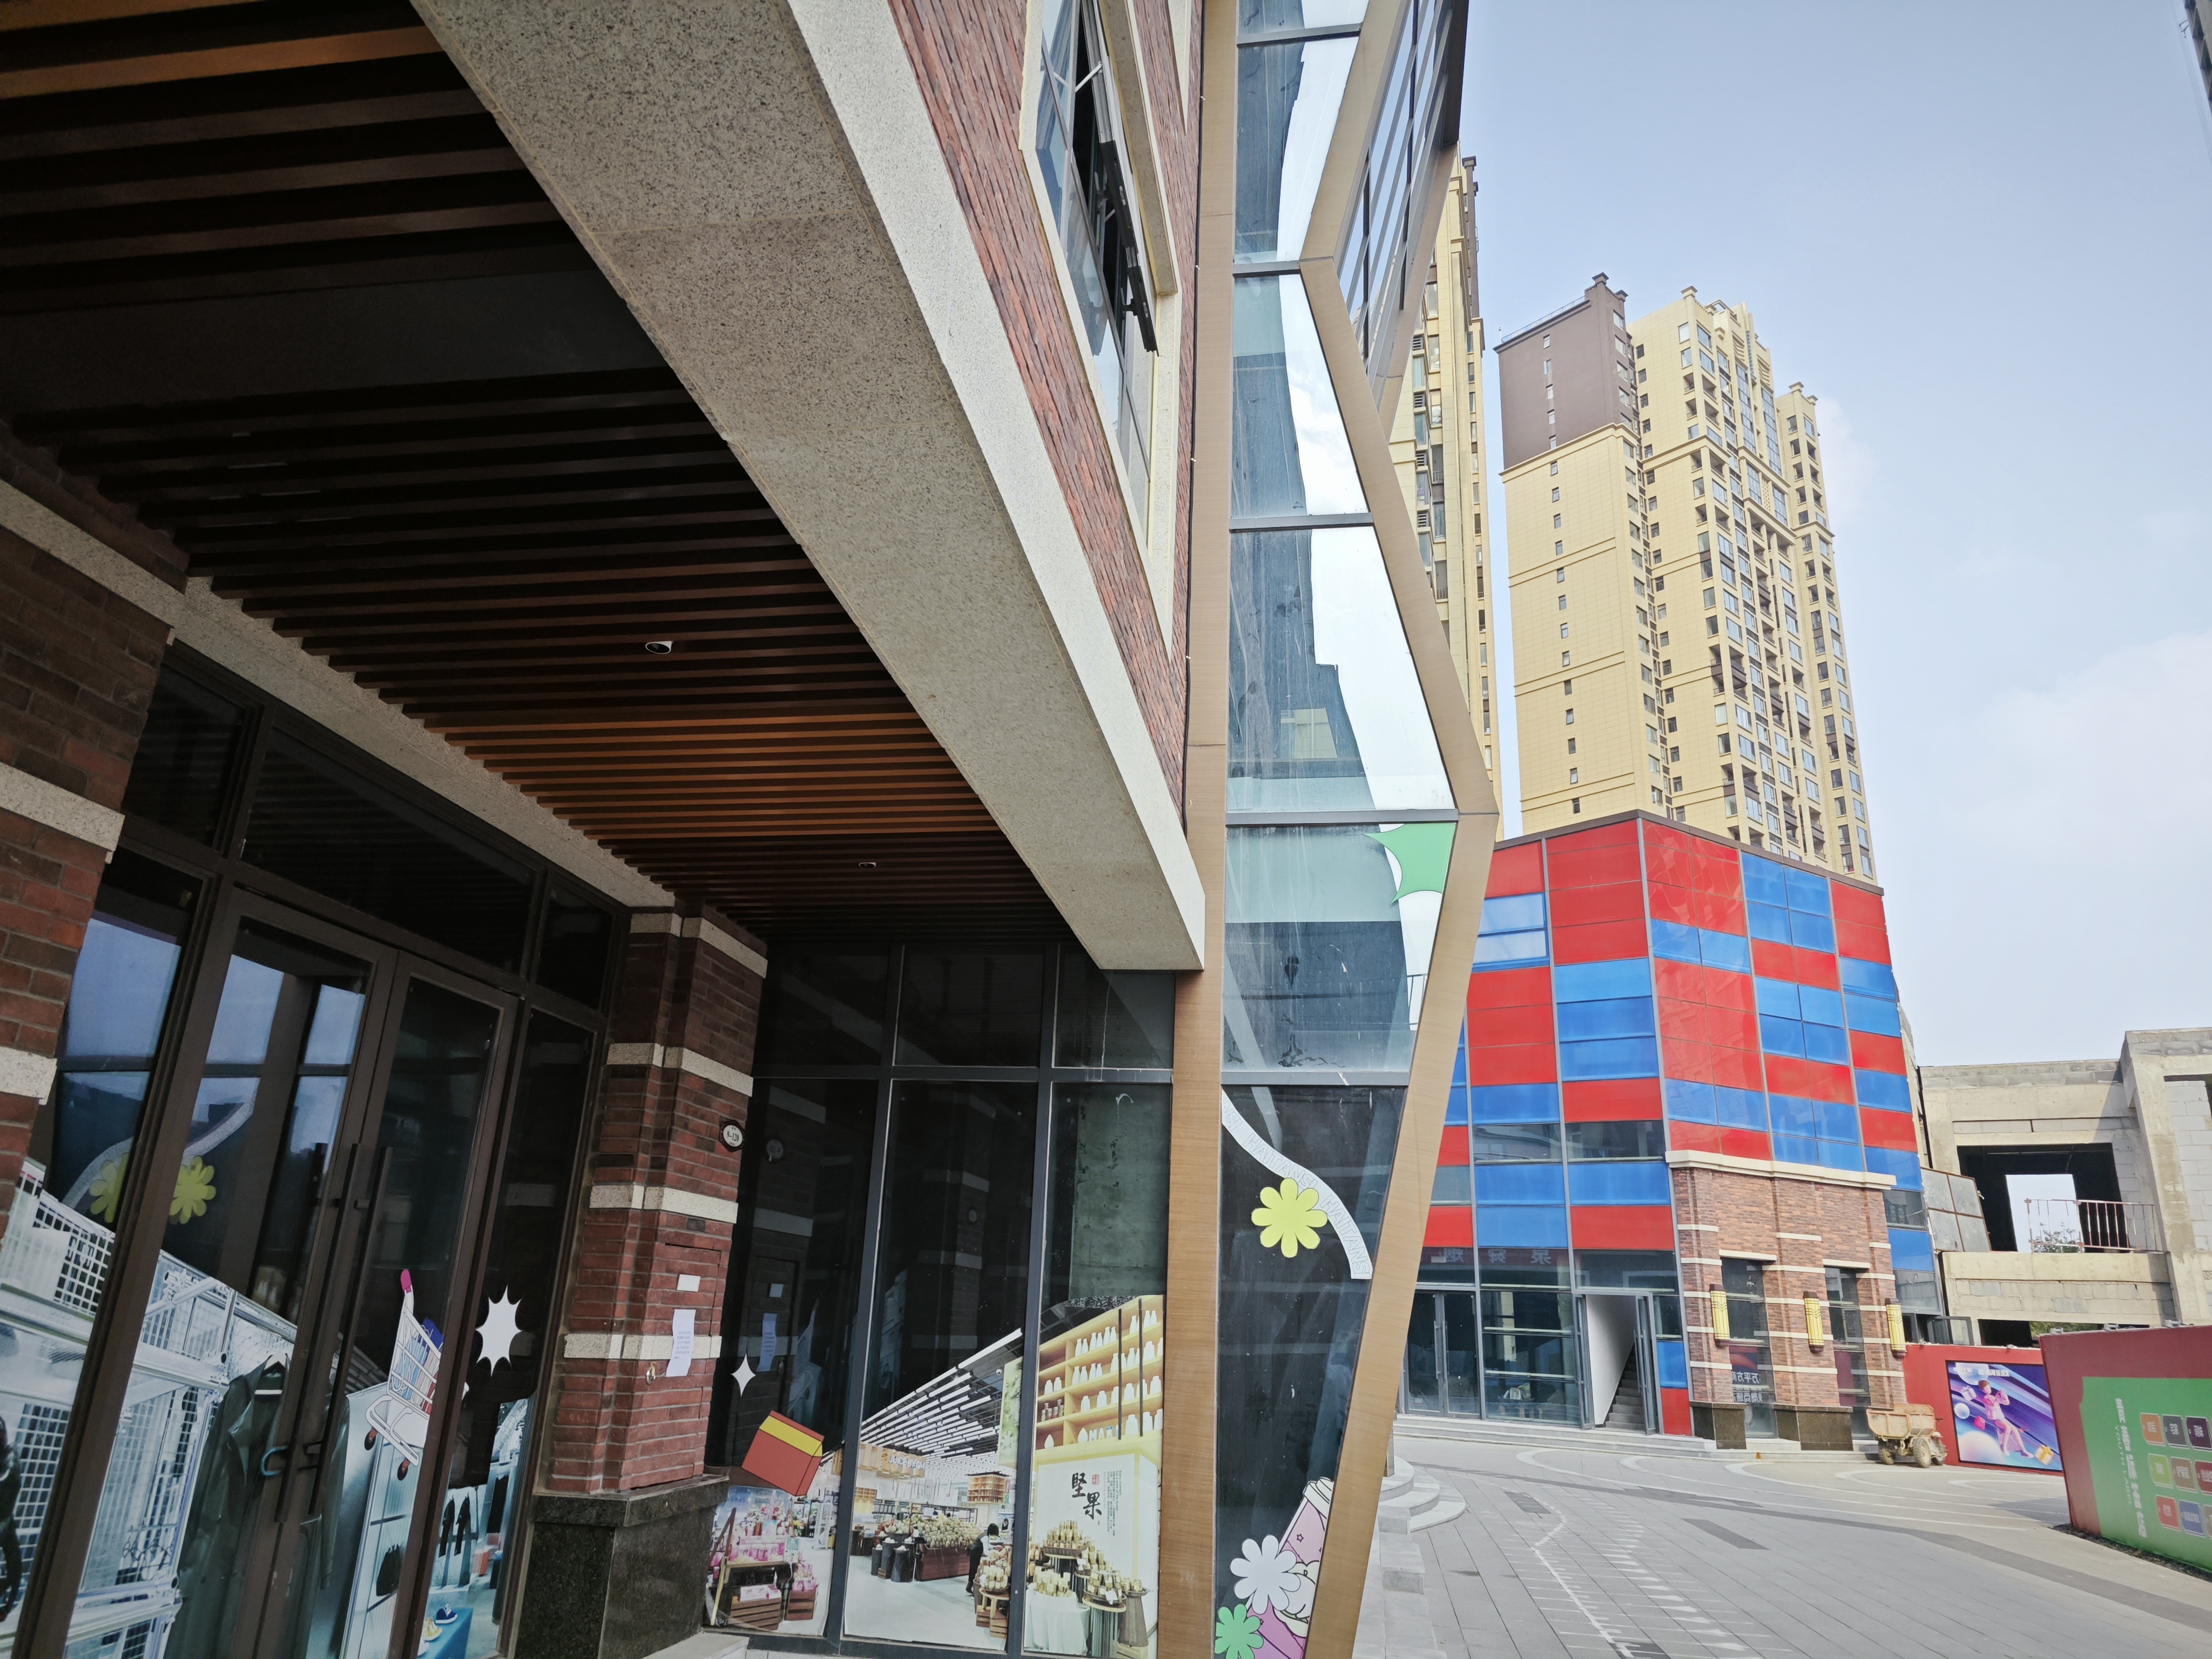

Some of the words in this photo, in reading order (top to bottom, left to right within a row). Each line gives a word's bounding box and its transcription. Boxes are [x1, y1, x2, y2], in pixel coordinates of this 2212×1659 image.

[727, 1130, 739, 1142] 9-120
[1243, 1133, 1318, 1190] HAITANSI
[1320, 1195, 1371, 1278] HAITANSI
[2115, 1425, 2126, 1466] YOUTH
